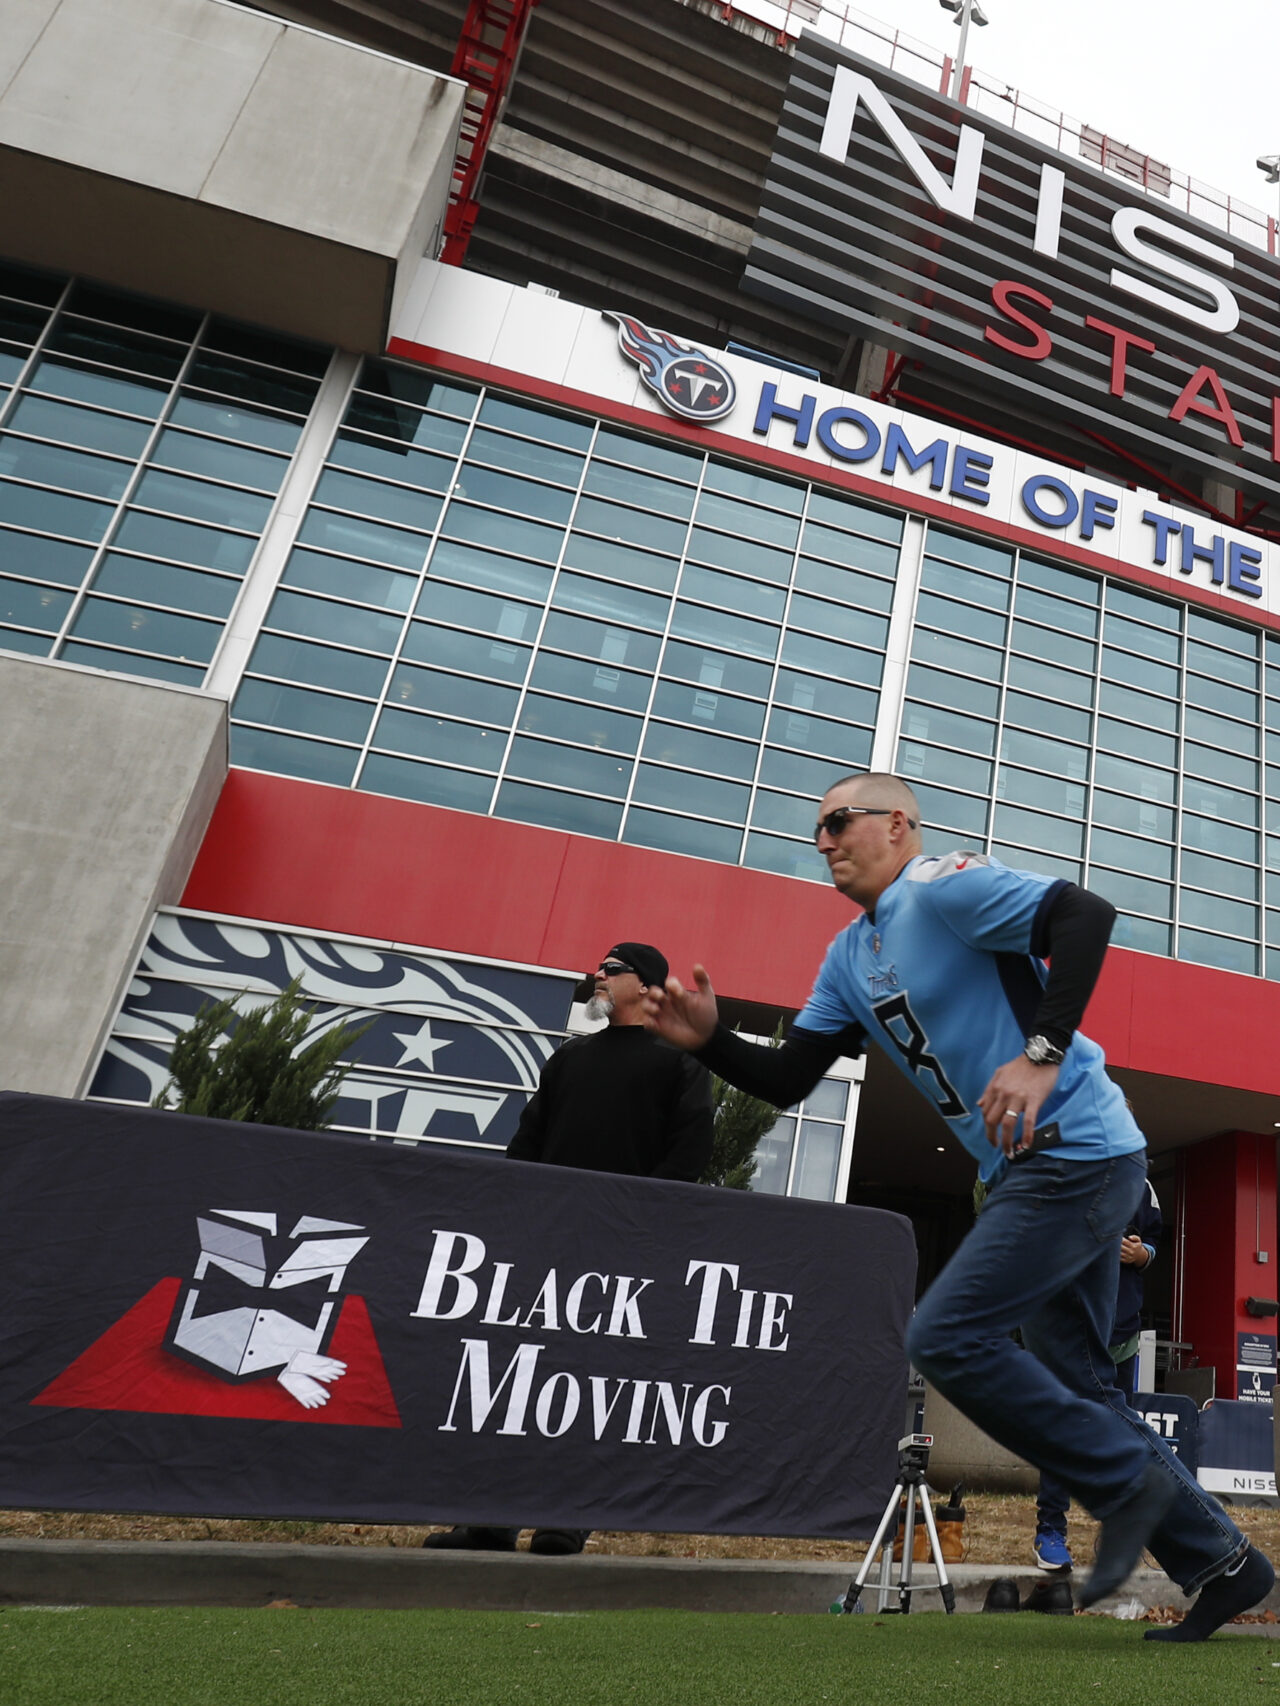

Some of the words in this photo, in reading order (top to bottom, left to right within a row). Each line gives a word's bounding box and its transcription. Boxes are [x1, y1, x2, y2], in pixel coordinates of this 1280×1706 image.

[753, 381, 994, 507] HOME
[1021, 474, 1118, 541] OF
[1141, 509, 1263, 600] THE
[410, 1229, 655, 1339] BLACK
[684, 1259, 794, 1352] TIE
[438, 1338, 732, 1447] MOVING
